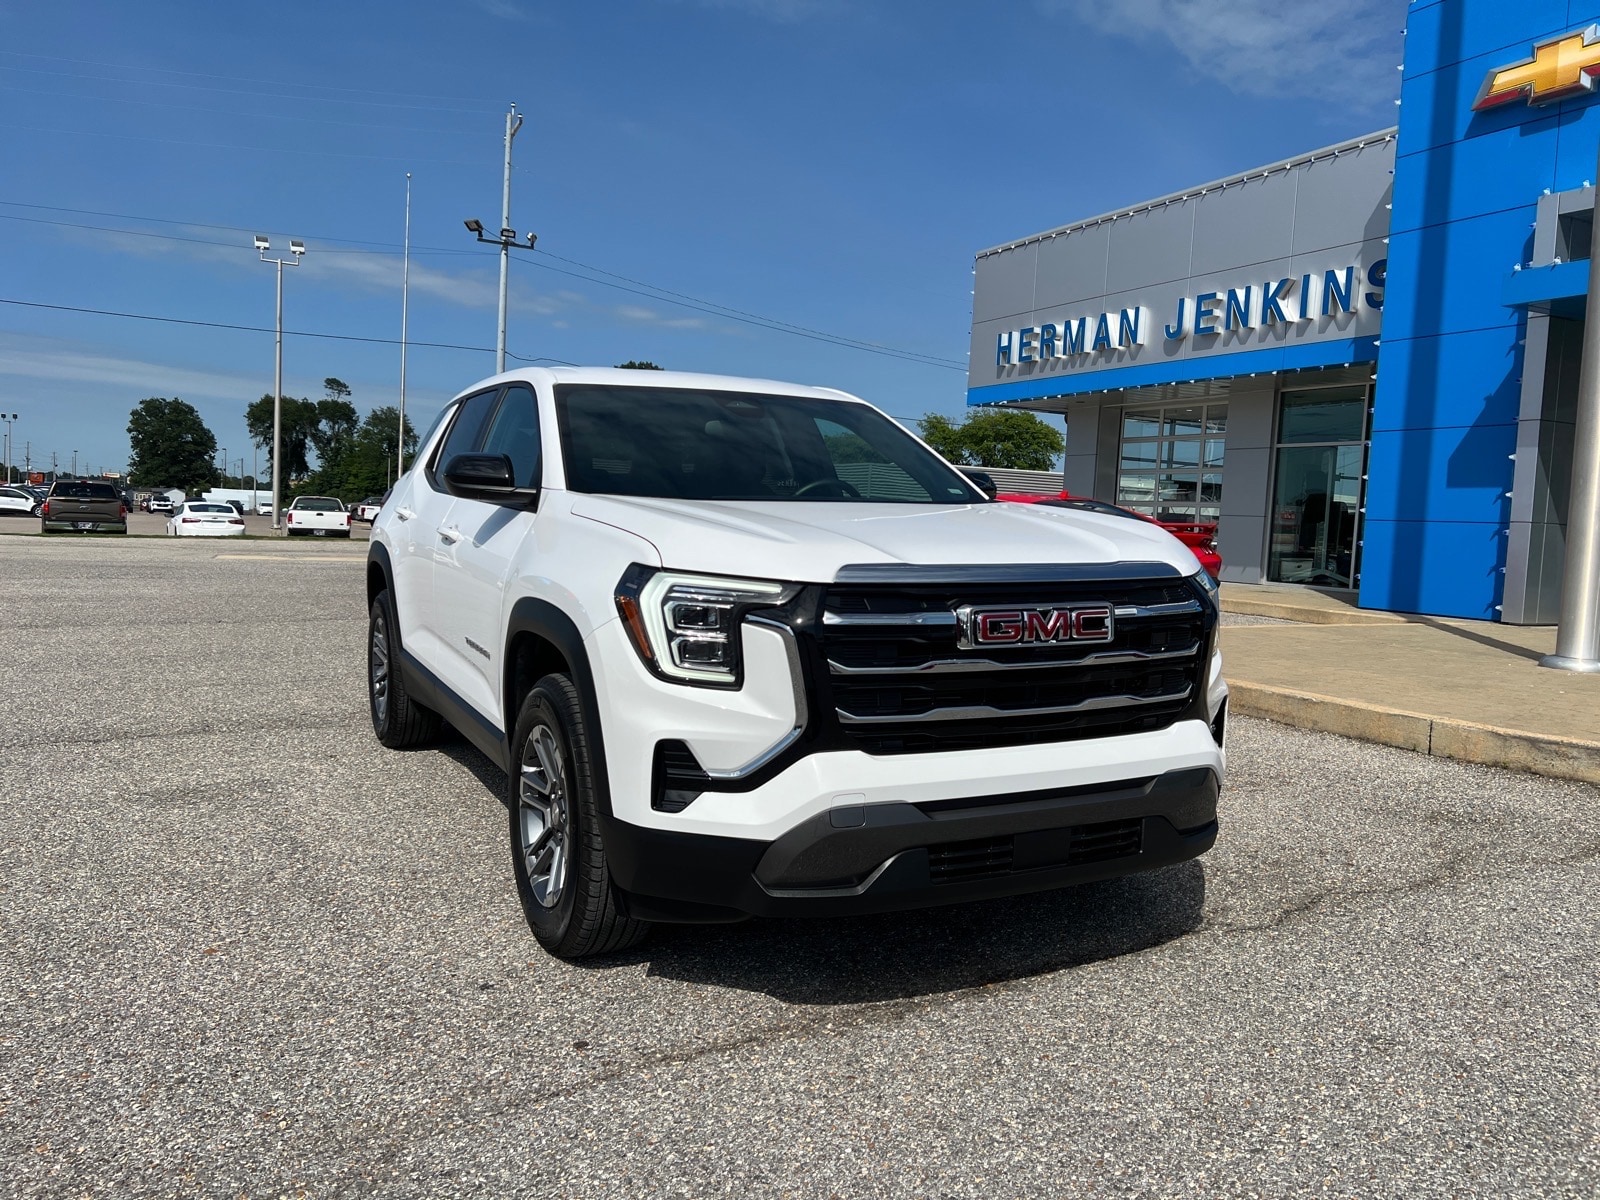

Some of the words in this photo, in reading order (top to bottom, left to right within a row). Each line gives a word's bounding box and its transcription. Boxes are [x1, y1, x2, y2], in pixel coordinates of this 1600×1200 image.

[996, 306, 1143, 366] HERMAN
[1164, 258, 1388, 341] JENKINS
[978, 609, 1110, 642] GMC
